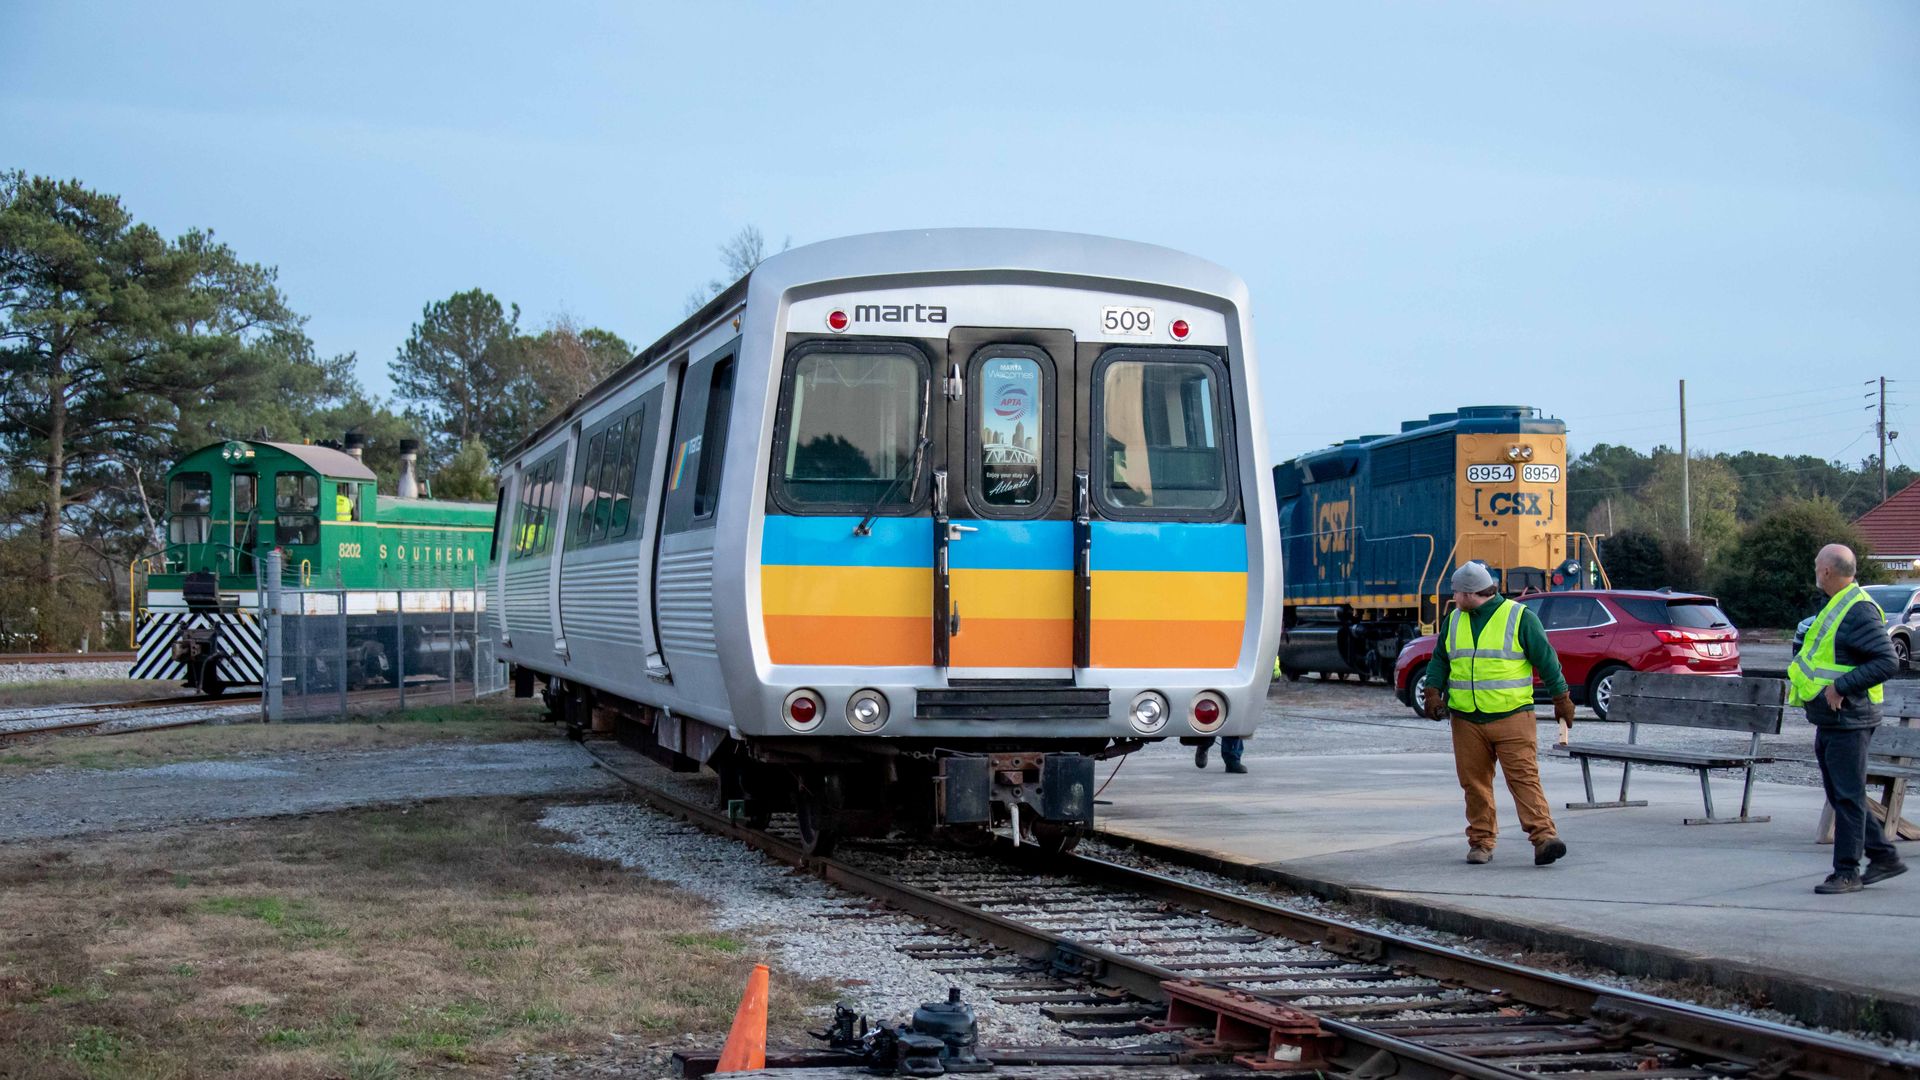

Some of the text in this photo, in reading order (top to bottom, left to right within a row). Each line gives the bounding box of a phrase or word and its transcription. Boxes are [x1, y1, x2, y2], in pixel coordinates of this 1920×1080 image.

[855, 304, 947, 322] marta
[1105, 311, 1150, 331] 509
[988, 370, 1034, 379] Welcomes
[1469, 466, 1513, 481] 8954
[1524, 466, 1558, 481] 8954
[989, 474, 1034, 496] Atlanta!
[1490, 492, 1542, 515] CSX
[1319, 500, 1349, 553] CSX
[339, 543, 361, 558] 8202
[379, 544, 475, 562] SOUTHERN
